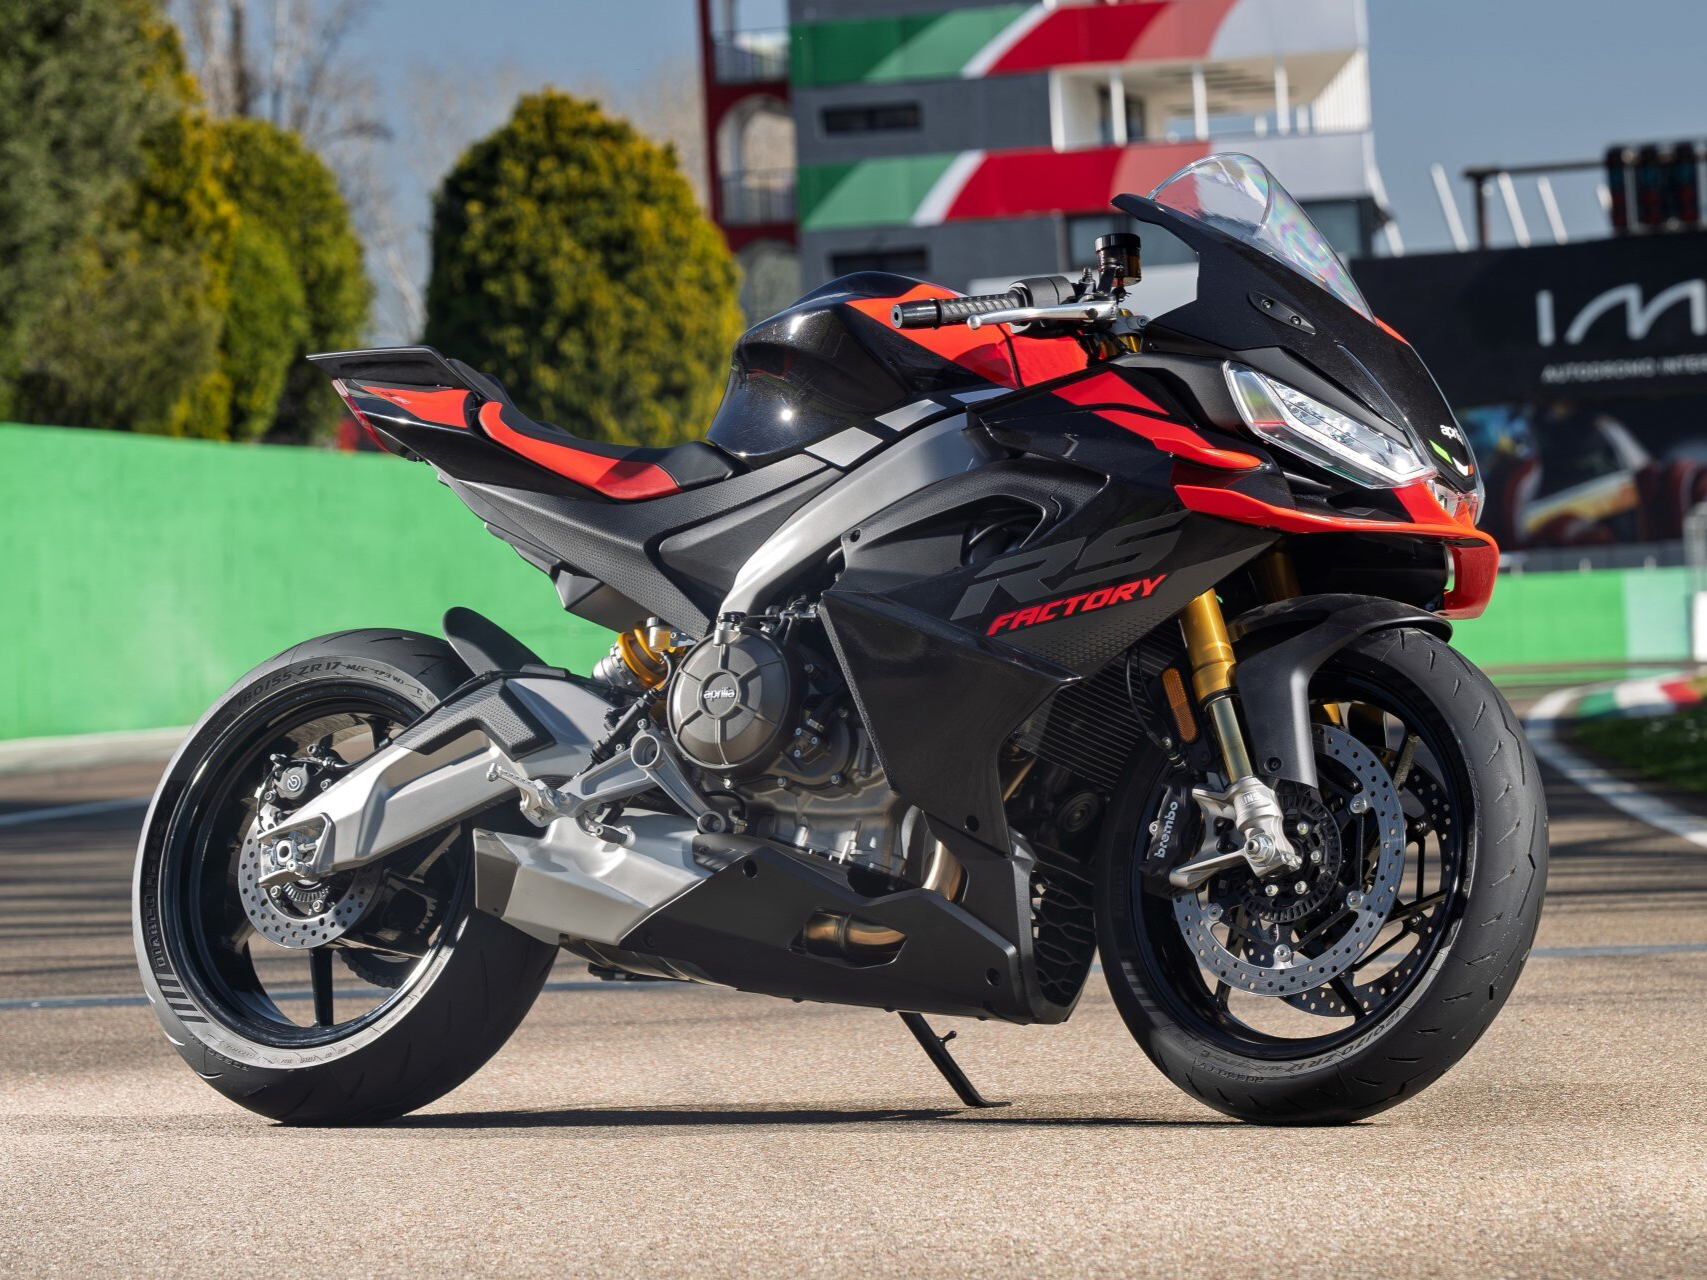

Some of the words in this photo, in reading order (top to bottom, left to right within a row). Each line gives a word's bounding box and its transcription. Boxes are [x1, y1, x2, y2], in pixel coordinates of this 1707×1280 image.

[1541, 358, 1656, 384] AUTODROMO
[950, 509, 1192, 620] RS
[987, 574, 1167, 636] FACTORY
[703, 687, 735, 701] aprilia
[1154, 801, 1178, 858] brembo
[144, 894, 166, 969] DIABLO
